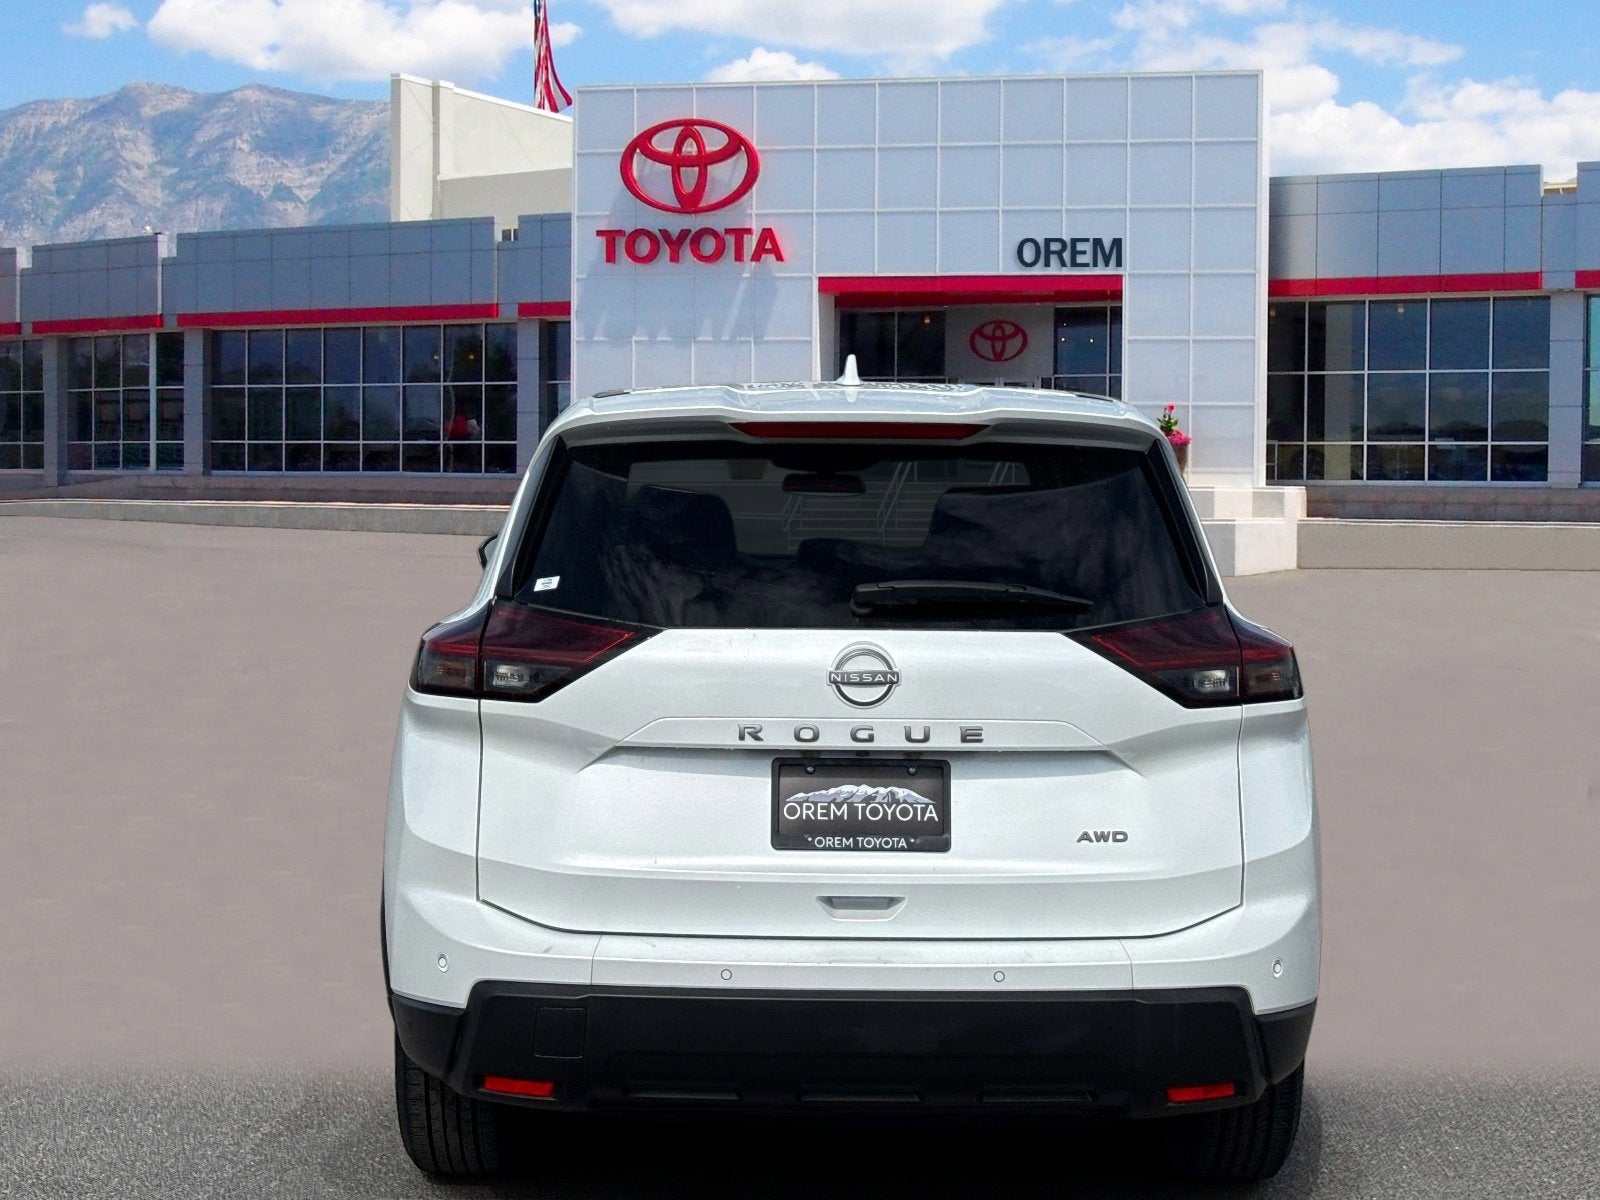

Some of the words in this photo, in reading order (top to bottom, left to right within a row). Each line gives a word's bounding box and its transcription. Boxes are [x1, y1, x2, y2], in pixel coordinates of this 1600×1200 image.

[596, 227, 785, 263] TOYOTA
[1015, 237, 1123, 268] OREM
[829, 672, 899, 684] NISSAN
[737, 723, 985, 744] ROGUE
[783, 802, 848, 820] OREM
[854, 803, 939, 822] TOYOTA
[814, 836, 853, 848] OREM
[857, 837, 907, 849] TOYOTA
[1076, 830, 1129, 843] AWD
